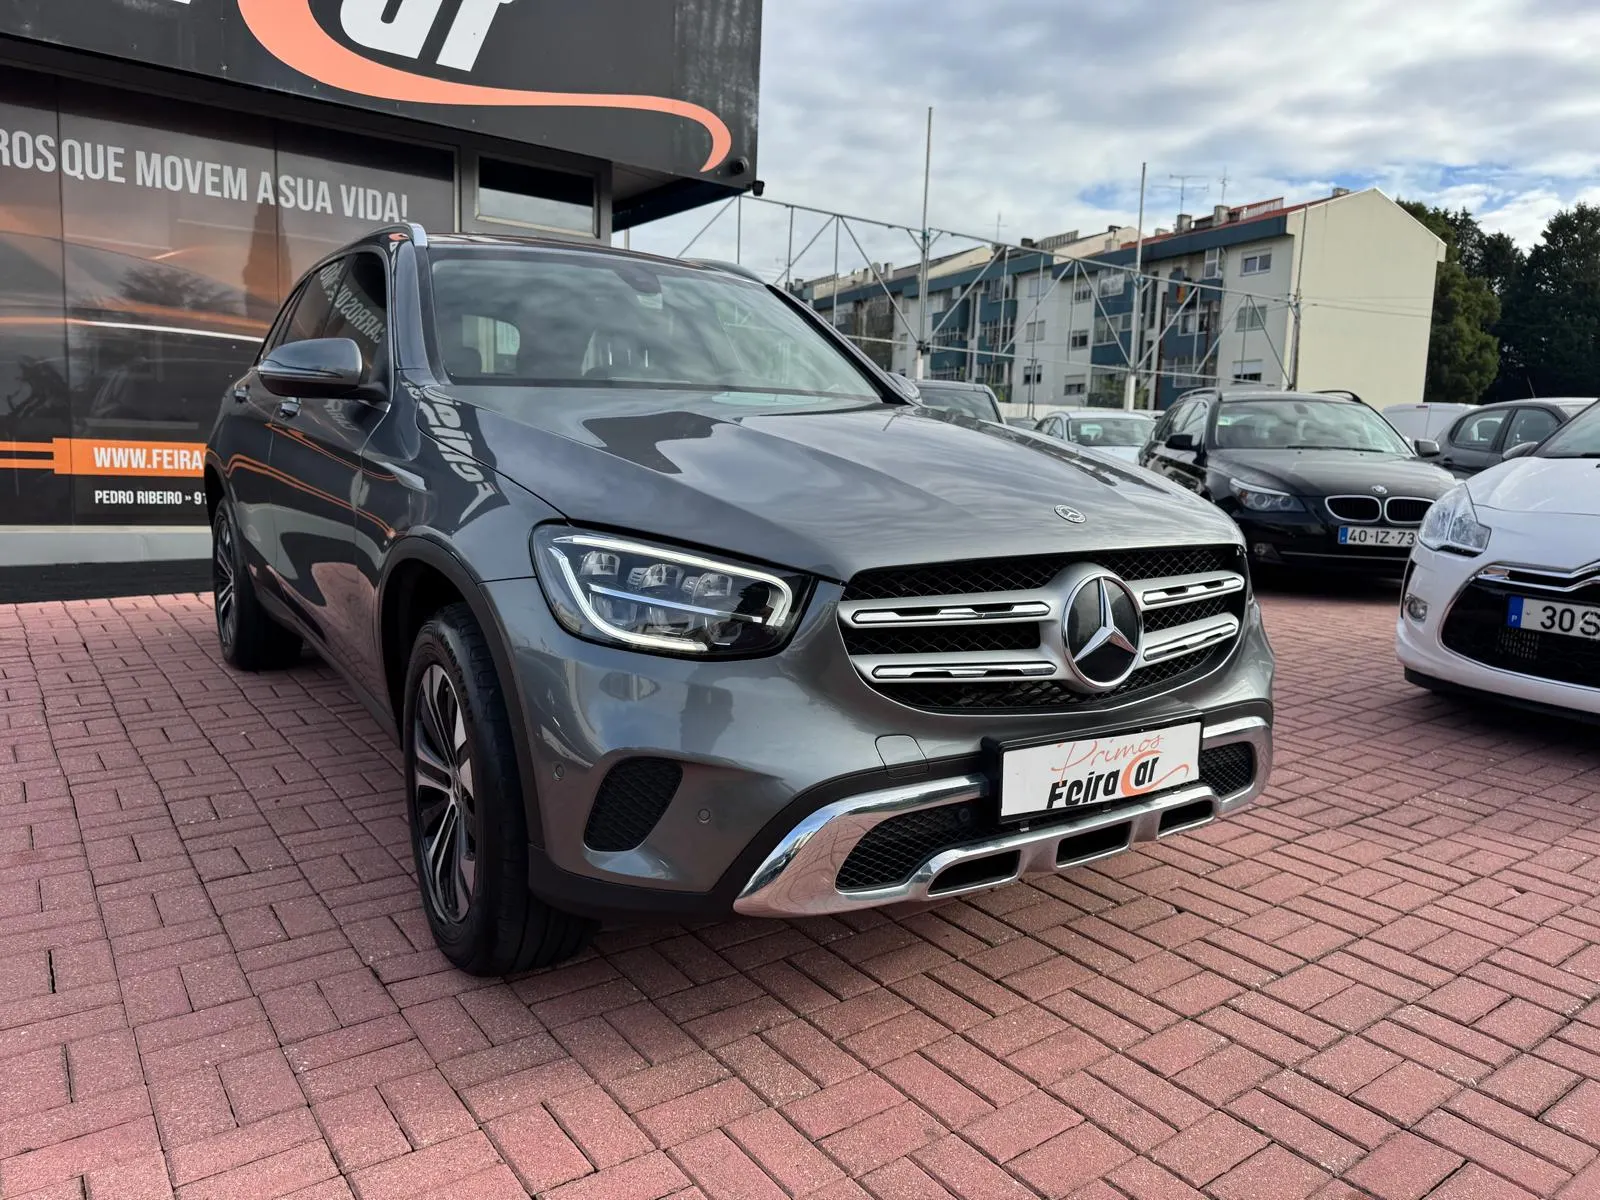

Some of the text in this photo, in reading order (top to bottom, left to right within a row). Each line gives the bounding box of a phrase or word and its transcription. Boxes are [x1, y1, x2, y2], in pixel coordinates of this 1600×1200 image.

[61, 138, 126, 184] QUE
[135, 151, 248, 202] MOVEM
[256, 171, 276, 206] A
[278, 174, 333, 215] SUA
[340, 184, 408, 223] VIDA!
[93, 447, 205, 471] WWW.FEIRA
[94, 490, 133, 505] PEDRO
[137, 490, 182, 505] RIBEIRO
[1050, 734, 1164, 786] Primos
